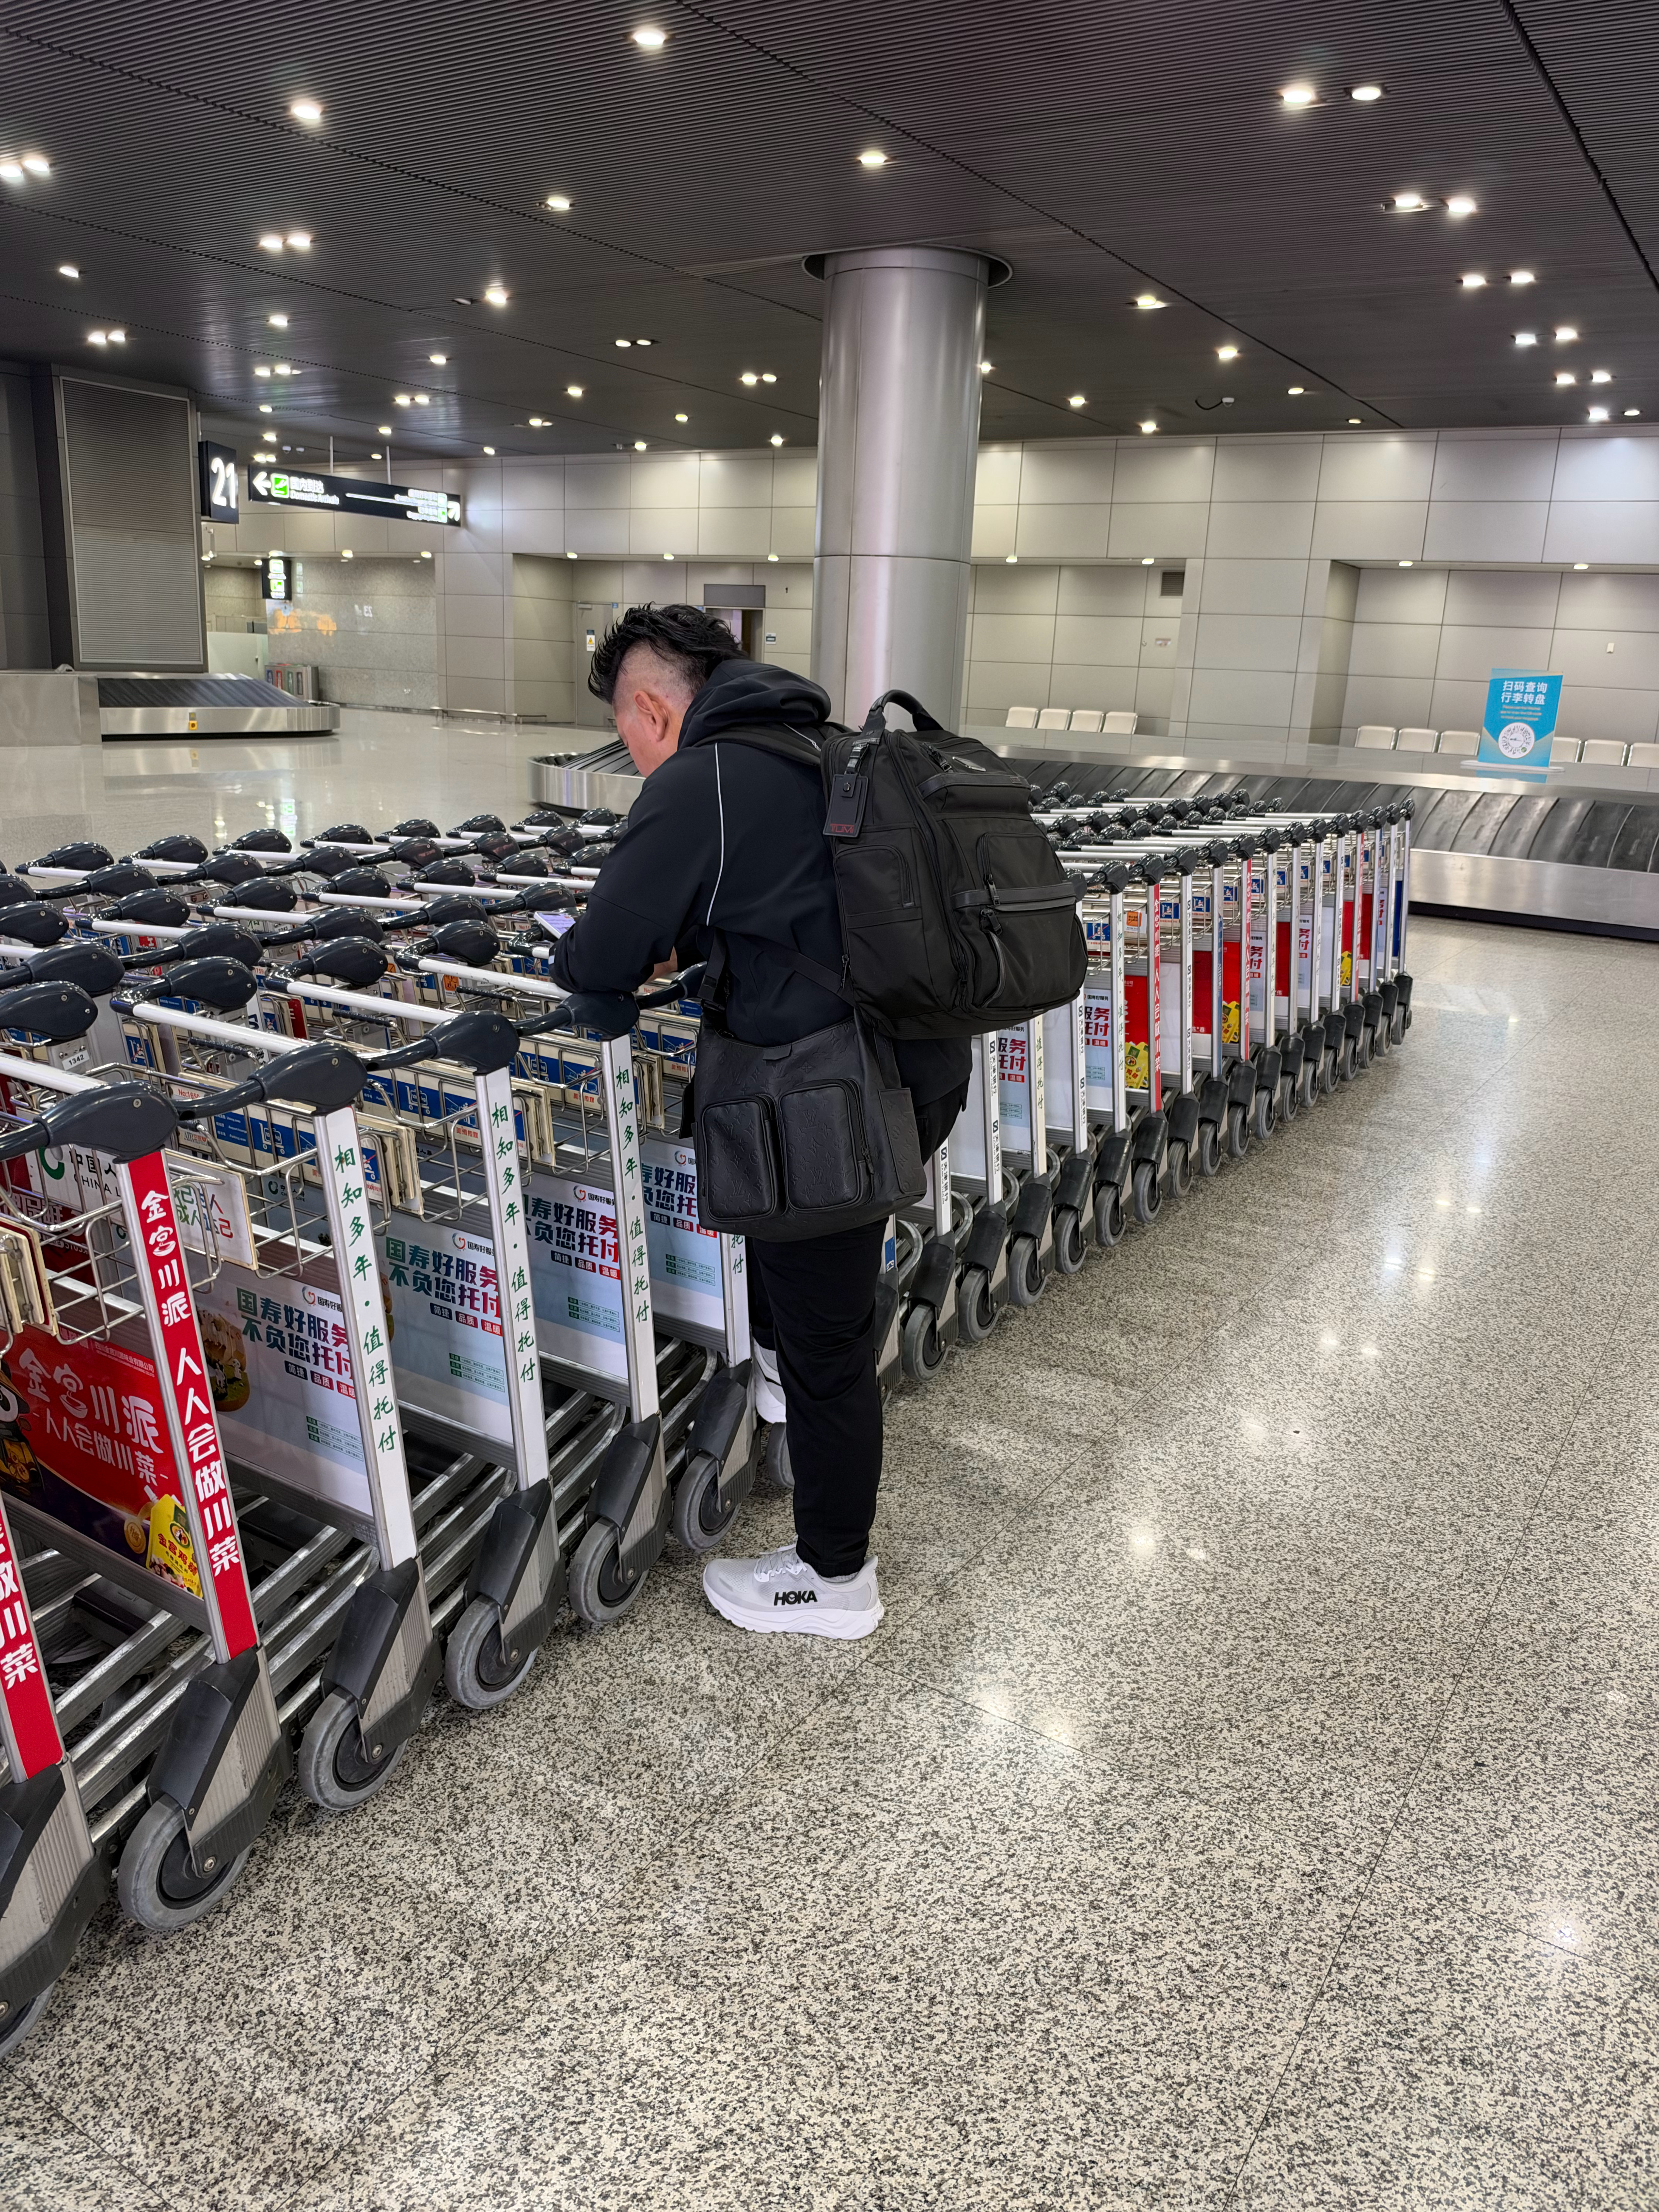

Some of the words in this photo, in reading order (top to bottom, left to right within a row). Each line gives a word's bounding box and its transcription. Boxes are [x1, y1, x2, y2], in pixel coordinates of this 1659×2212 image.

[211, 457, 236, 508] 21
[1503, 680, 1547, 693] 扫码查询
[1501, 692, 1545, 704] 行李转盘
[830, 823, 855, 833] TUMI
[69, 1054, 84, 1065] 1342
[654, 1213, 668, 1224] 简捷
[676, 1219, 690, 1230] 品质
[386, 1237, 498, 1292] 国寿好服务
[554, 1252, 569, 1264] 简捷
[578, 1259, 593, 1271] 品质
[602, 1266, 618, 1278] 温暖
[389, 1262, 501, 1318] 不负您托付
[434, 1305, 450, 1319] 简捷
[237, 1287, 349, 1352] 国寿好服务
[459, 1313, 475, 1326] 品质
[484, 1321, 501, 1335] 温暖
[241, 1316, 353, 1380] 不负您托付
[287, 1362, 305, 1378] 简捷
[314, 1373, 330, 1388] 品质
[177, 1348, 240, 1577] 人人会做川菜
[774, 1590, 817, 1606] HOKA
